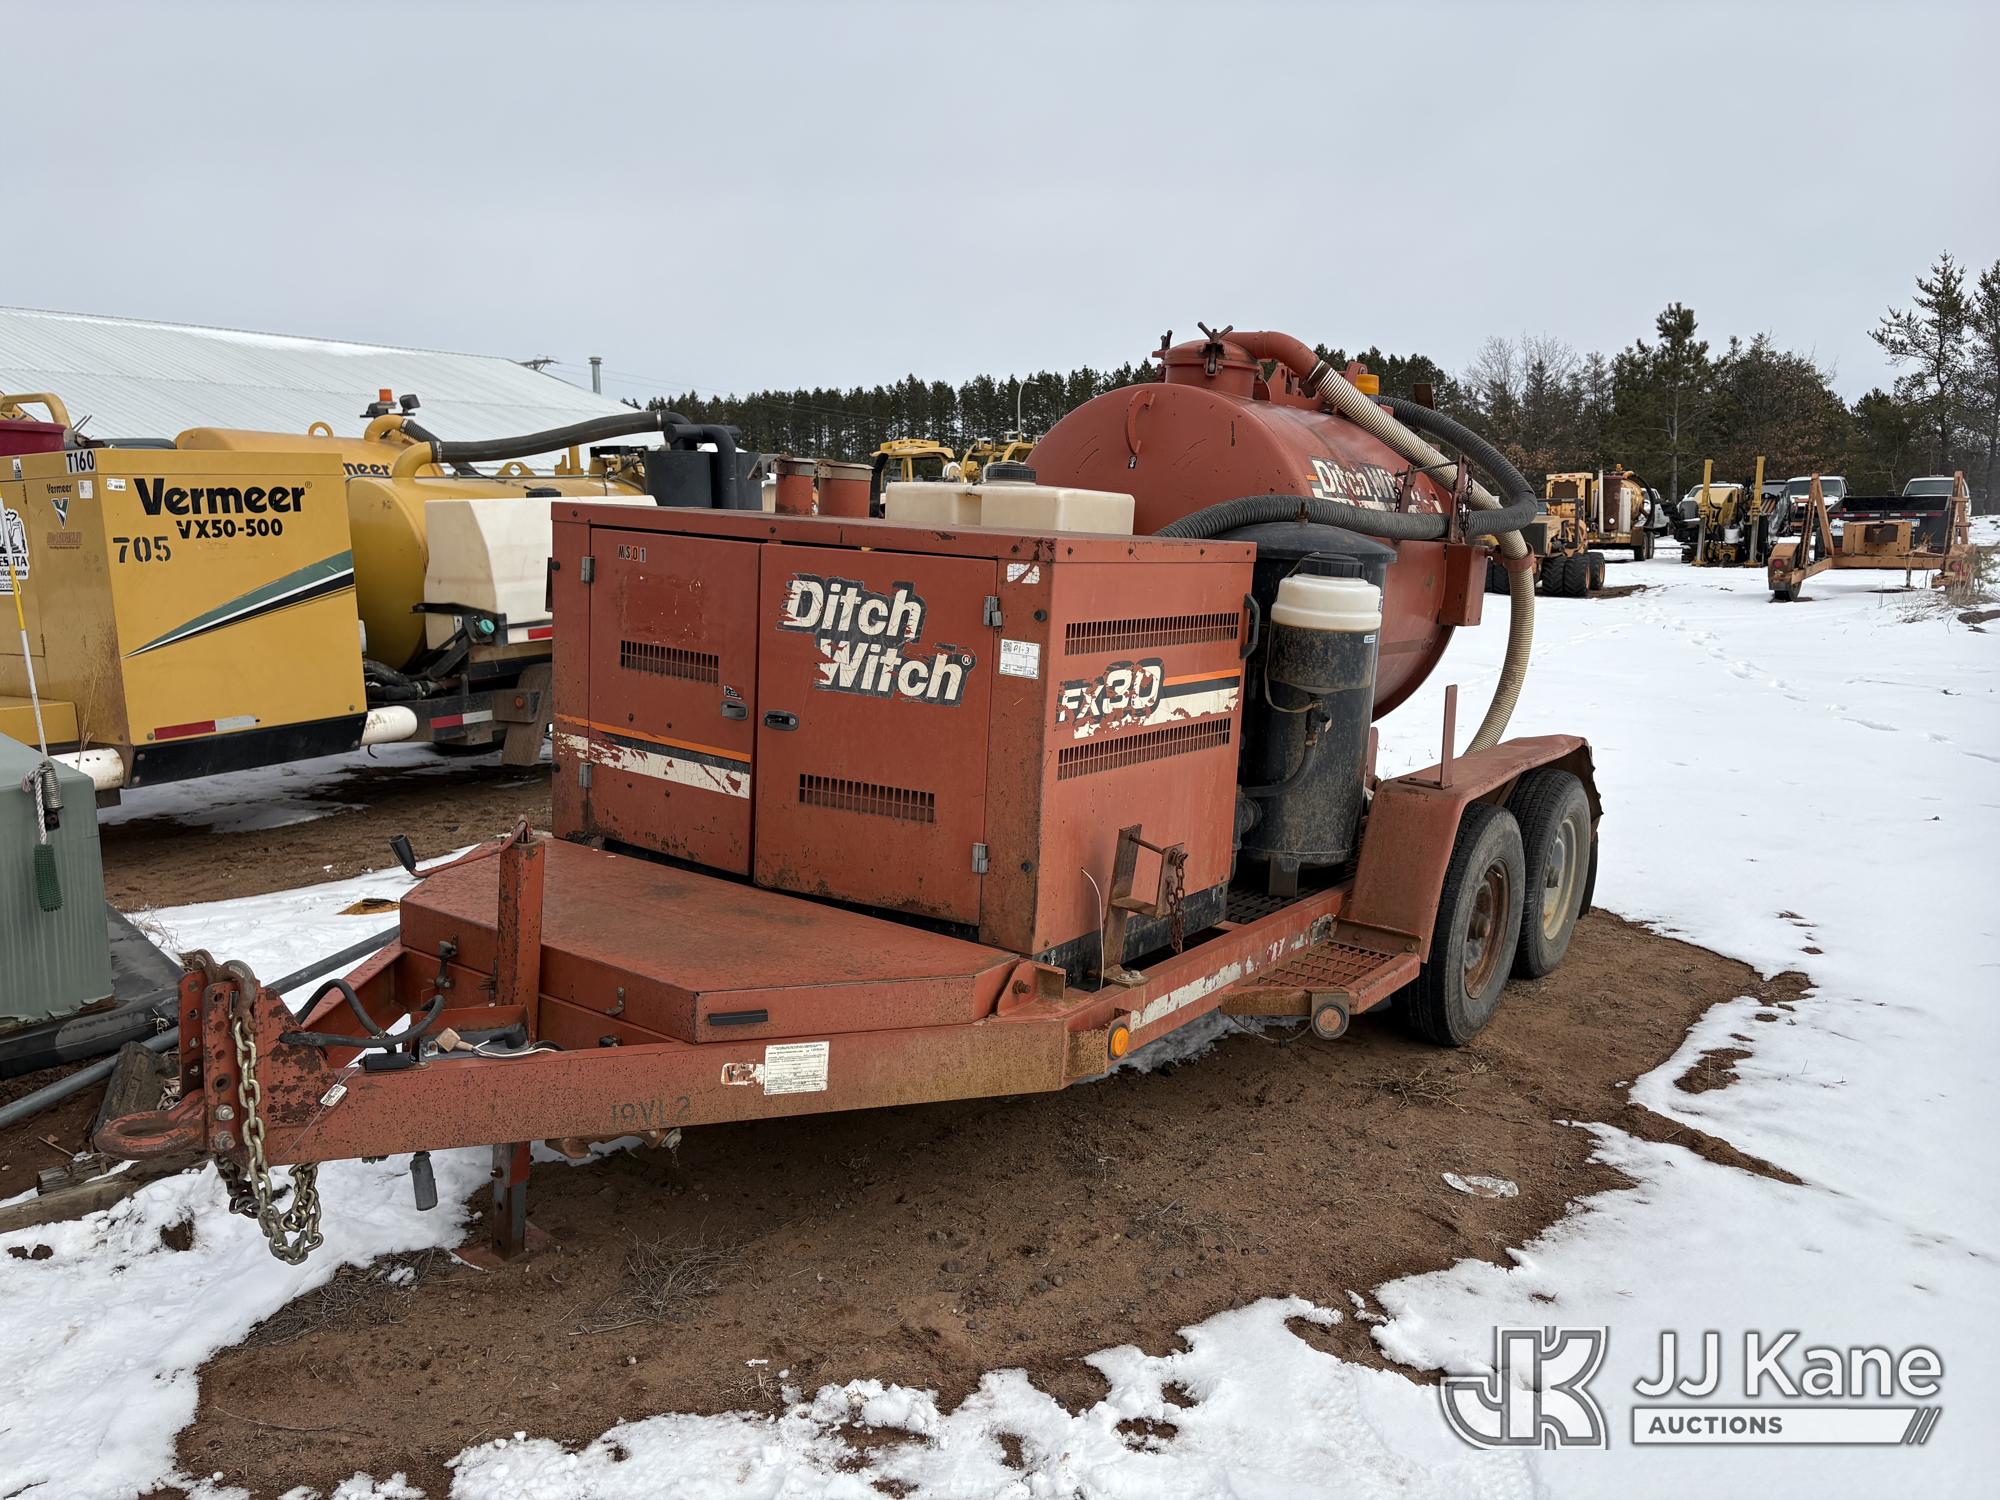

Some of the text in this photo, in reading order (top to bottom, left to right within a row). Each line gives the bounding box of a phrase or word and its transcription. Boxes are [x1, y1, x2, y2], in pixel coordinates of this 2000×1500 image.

[66, 451, 95, 473] T160
[46, 483, 72, 494] Vermeer
[133, 478, 306, 516] Vermeer
[176, 518, 283, 539] VX50-500
[112, 536, 171, 564] 705
[782, 578, 922, 640] Ditch
[817, 638, 966, 701] Witch
[1057, 659, 1164, 723] FX30
